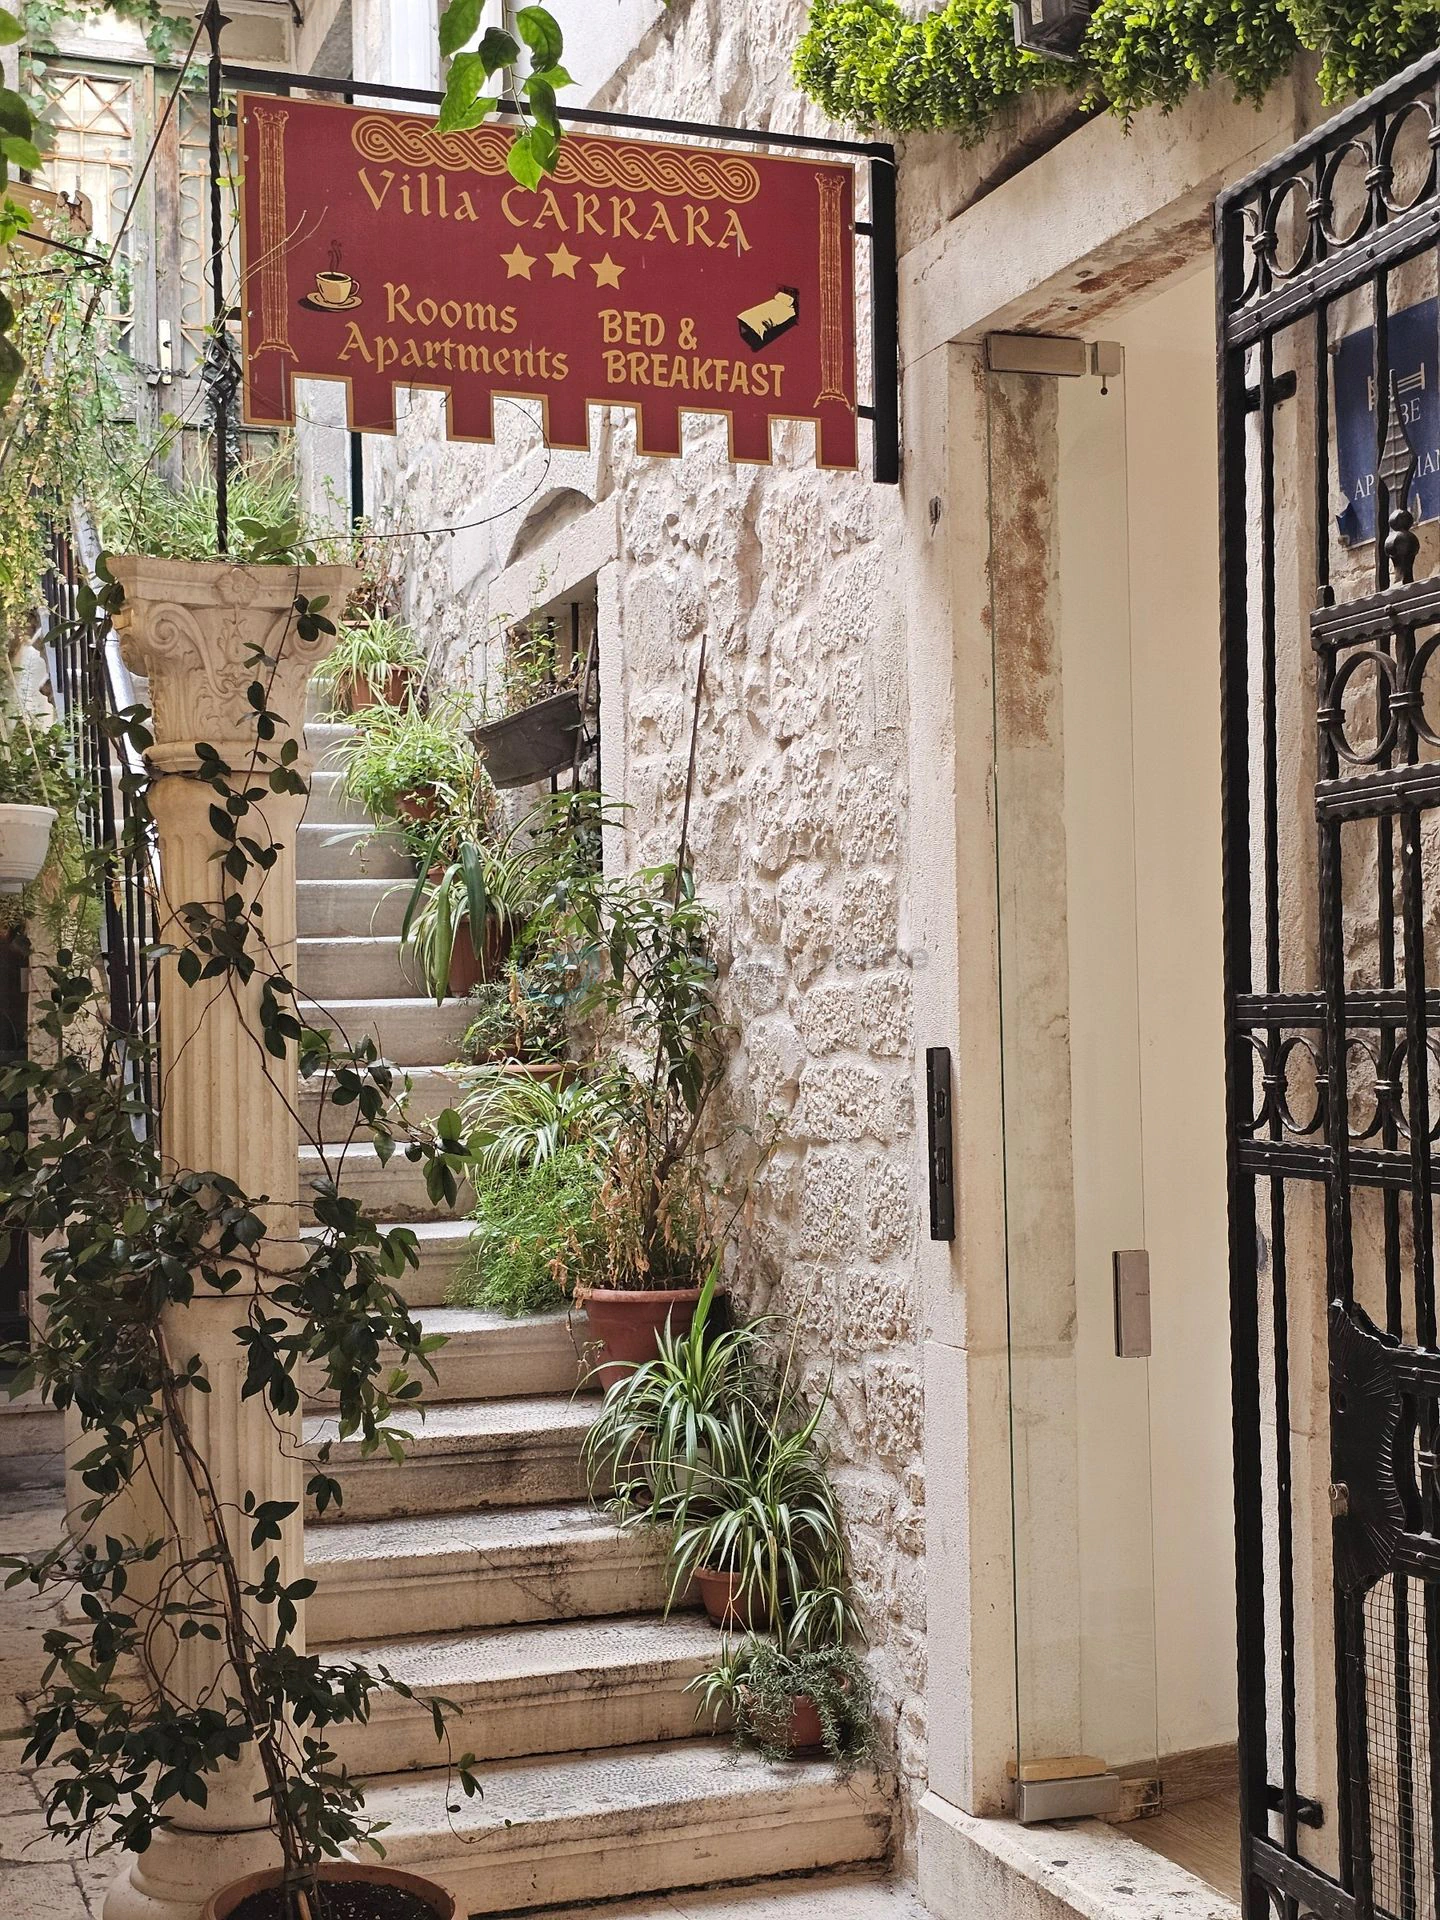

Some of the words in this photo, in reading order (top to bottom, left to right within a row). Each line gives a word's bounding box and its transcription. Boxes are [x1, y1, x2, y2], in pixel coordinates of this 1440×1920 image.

[357, 167, 480, 222] Villa
[500, 181, 753, 253] CARRARA
[382, 281, 518, 334] Rooms
[597, 308, 666, 348] BED
[676, 317, 698, 351] &
[337, 320, 570, 382] Apartments
[601, 348, 786, 398] BREAKFAST
